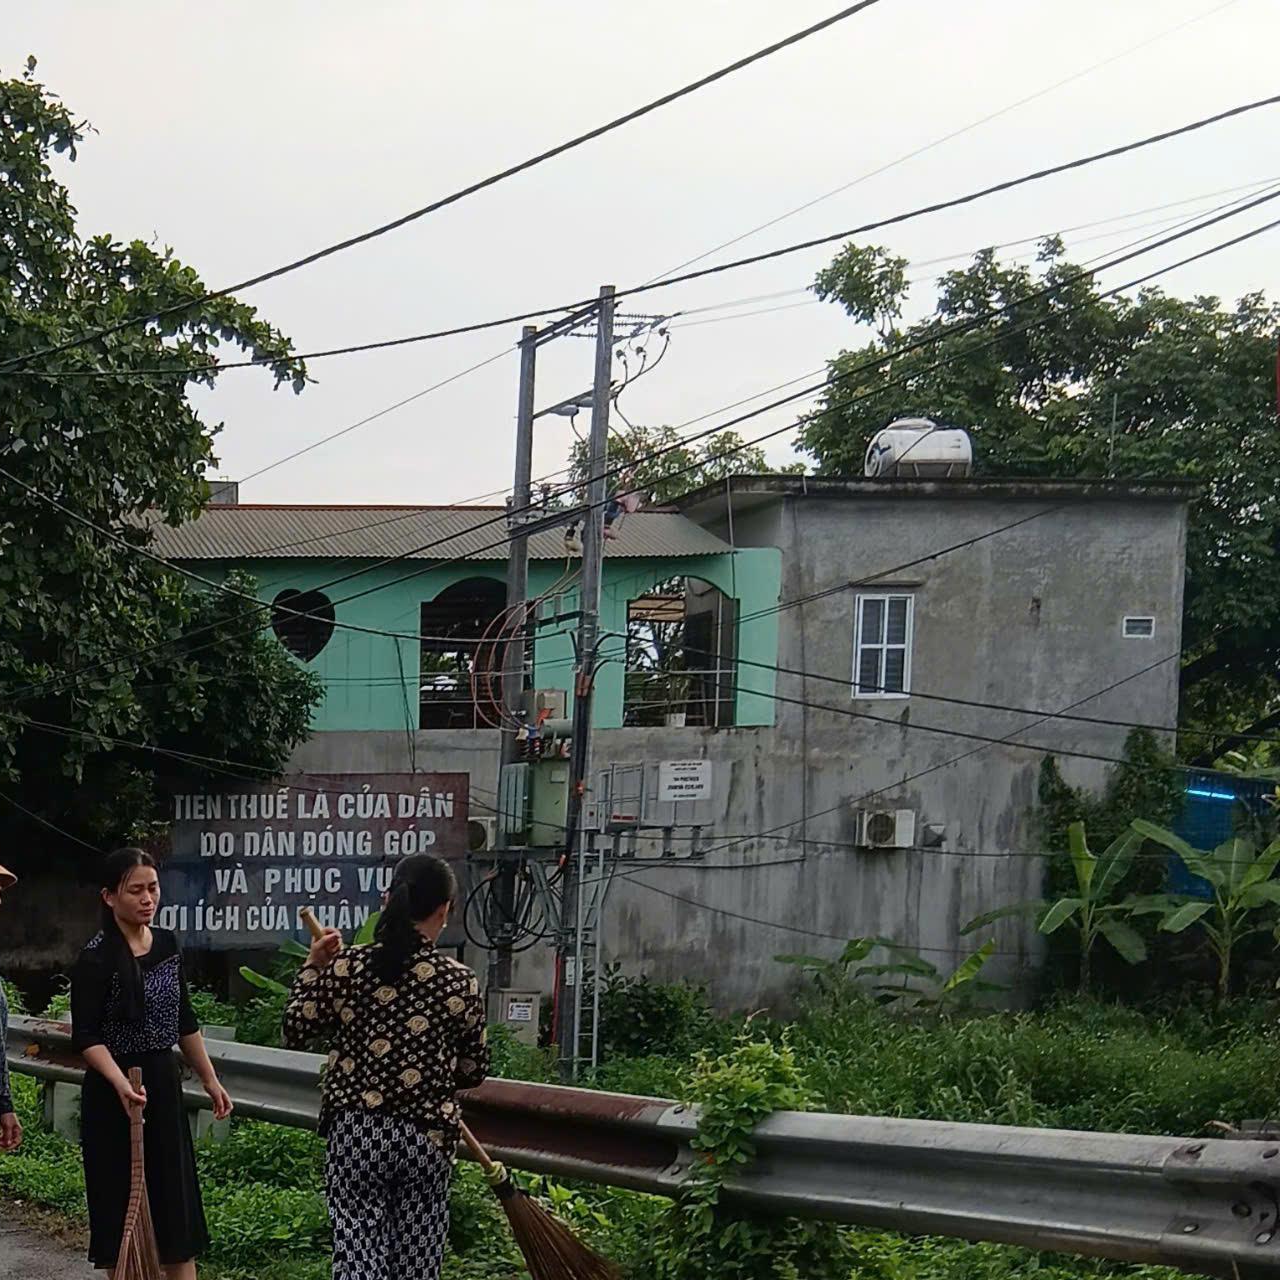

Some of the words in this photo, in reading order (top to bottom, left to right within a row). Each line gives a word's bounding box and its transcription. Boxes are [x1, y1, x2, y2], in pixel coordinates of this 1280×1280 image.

[227, 787, 290, 820] THUẾ
[297, 788, 330, 819] LÀ
[337, 783, 392, 819] CỦA
[398, 786, 454, 818] DÂN
[200, 831, 235, 857] DO
[244, 826, 295, 857] DÂN
[302, 824, 372, 856] ĐÓNG
[384, 824, 436, 856] GÓP
[214, 863, 248, 894] VÀ
[264, 867, 341, 899] PHỤC
[195, 899, 239, 931] ÍCH
[246, 896, 290, 931] CỦA
